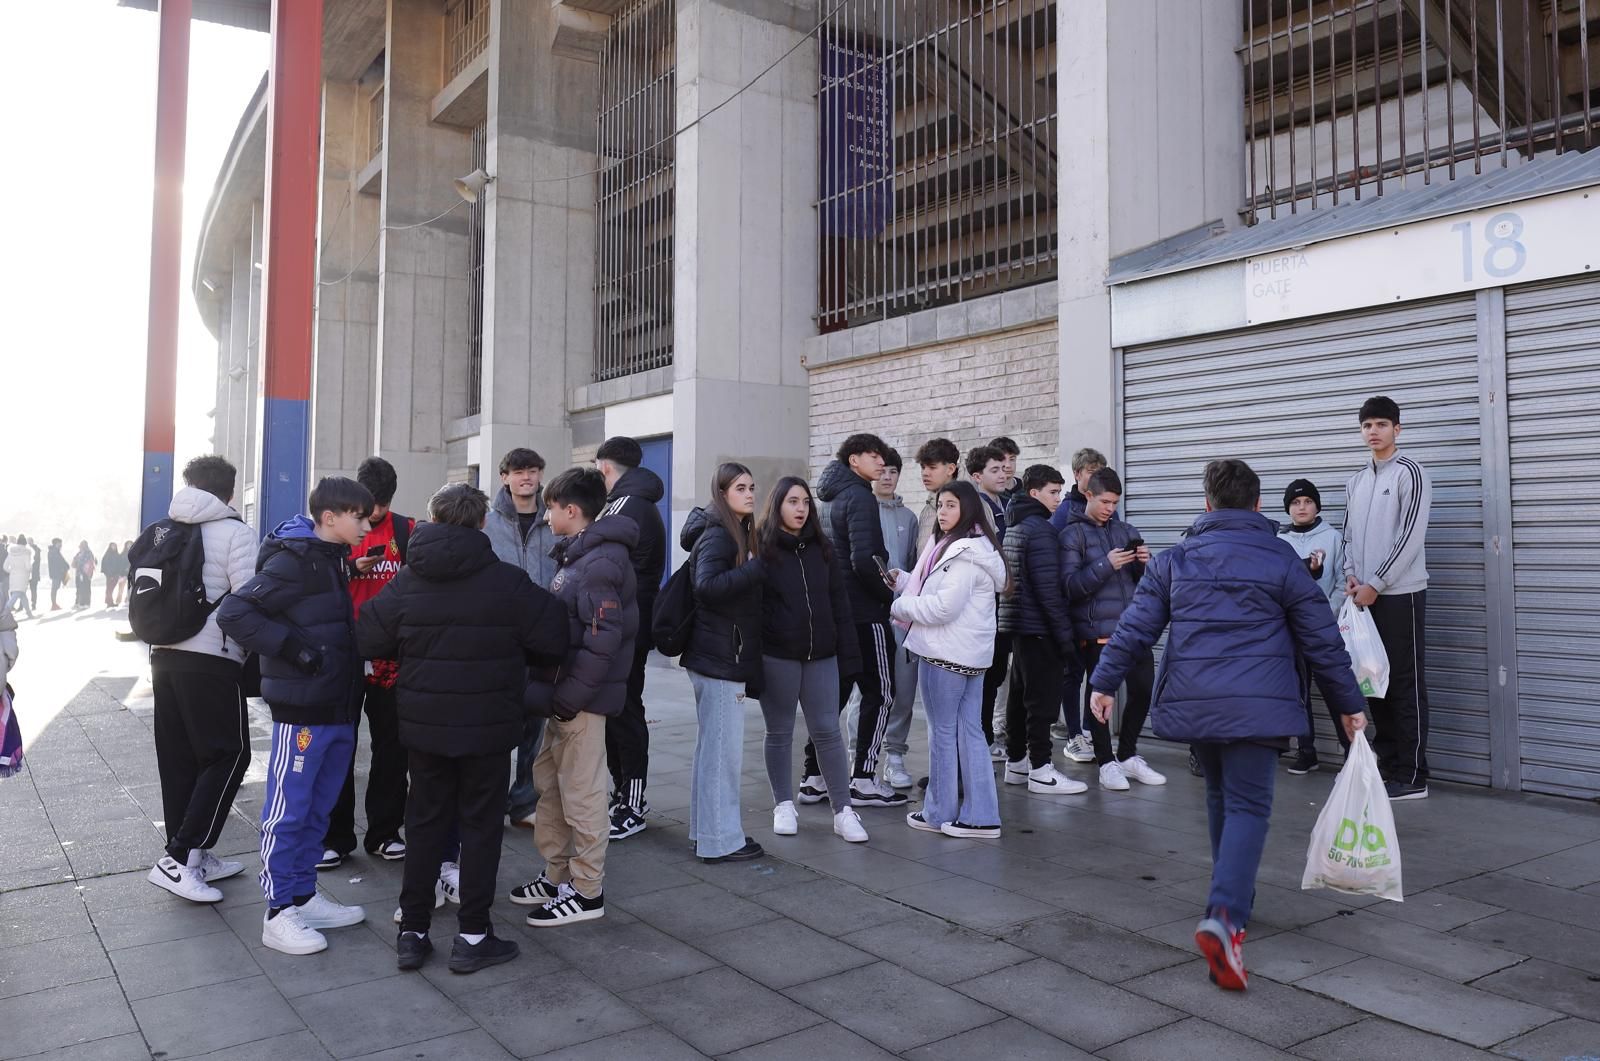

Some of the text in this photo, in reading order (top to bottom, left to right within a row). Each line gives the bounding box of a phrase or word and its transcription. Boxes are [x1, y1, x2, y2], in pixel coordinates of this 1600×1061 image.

[1451, 212, 1527, 283] 18
[1252, 253, 1309, 276] PUERTA
[1252, 278, 1292, 298] GATE
